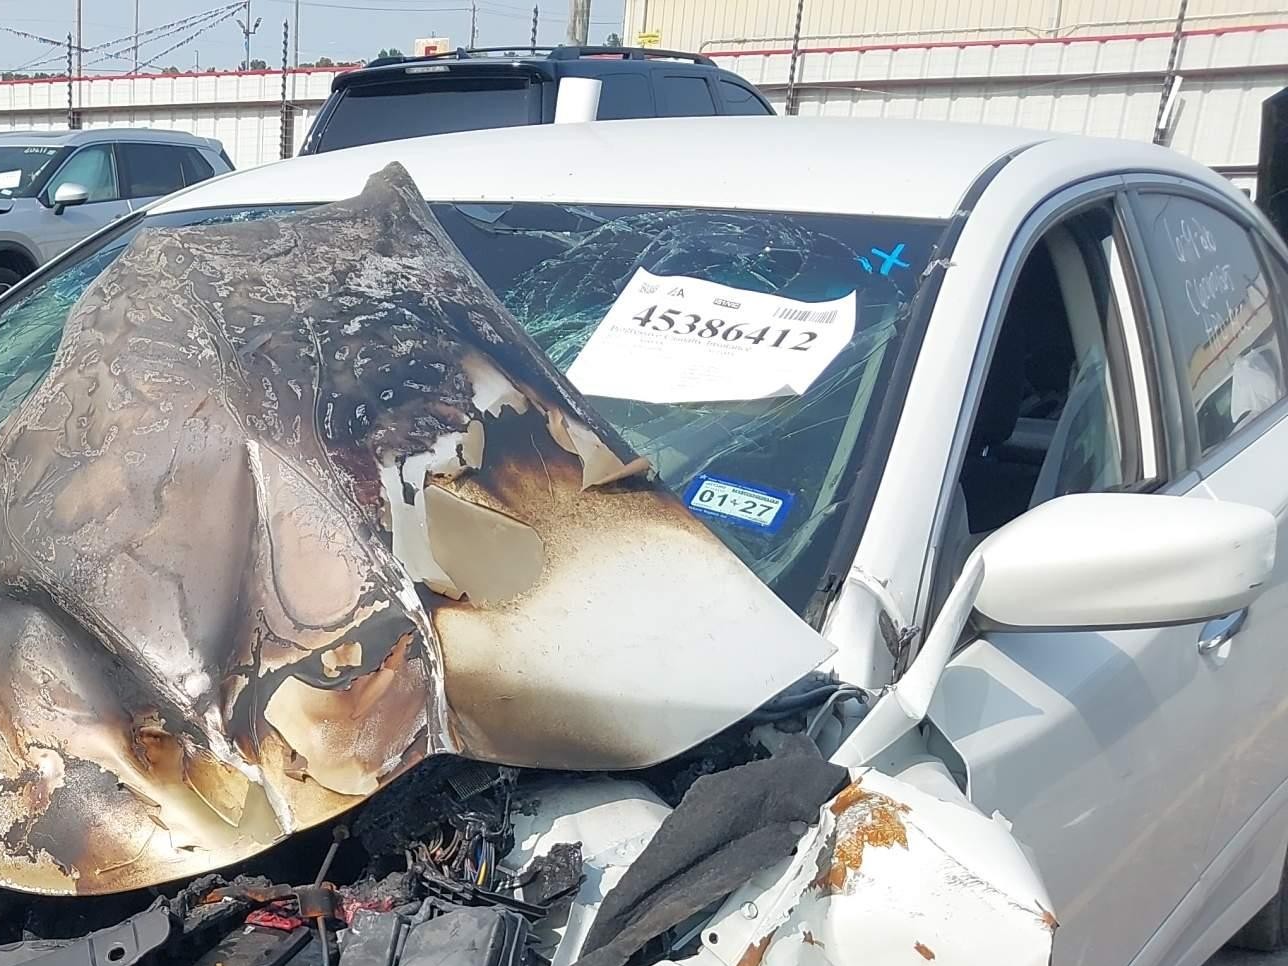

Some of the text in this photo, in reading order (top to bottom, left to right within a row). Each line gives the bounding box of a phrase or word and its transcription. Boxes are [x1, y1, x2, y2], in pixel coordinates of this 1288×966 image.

[632, 304, 818, 352] 45386412
[699, 490, 728, 507] 01
[738, 500, 773, 517] 27
